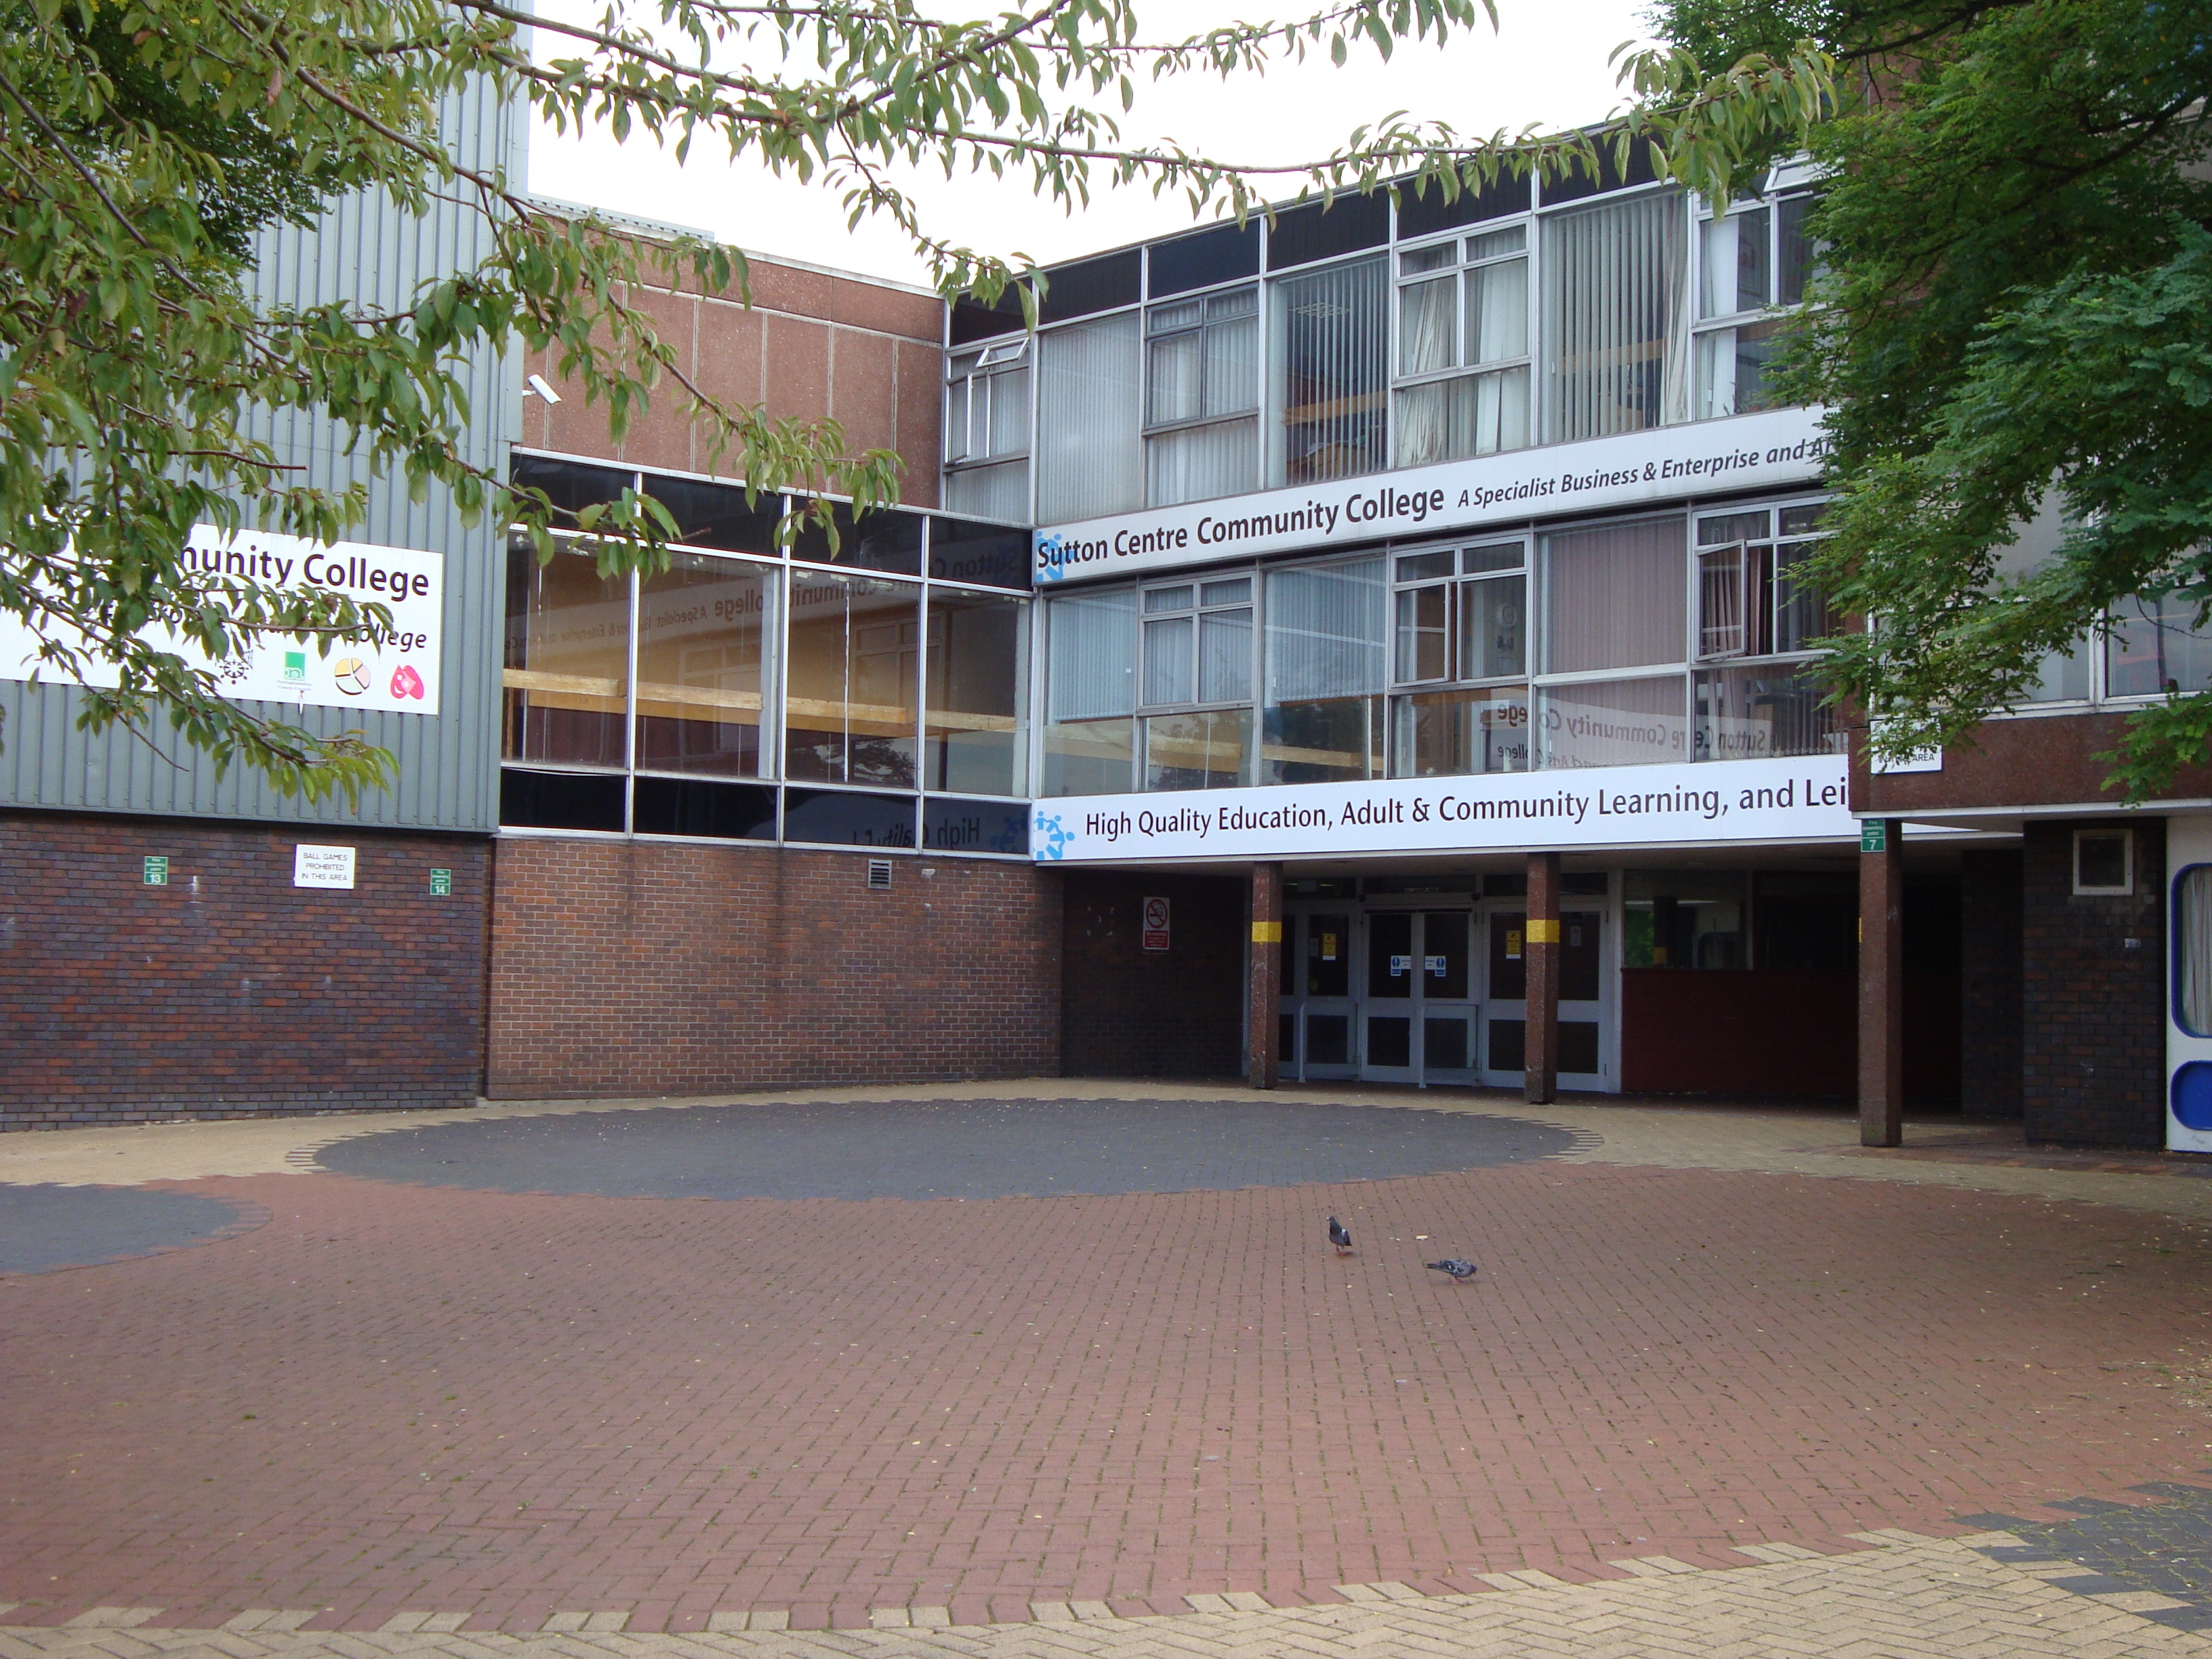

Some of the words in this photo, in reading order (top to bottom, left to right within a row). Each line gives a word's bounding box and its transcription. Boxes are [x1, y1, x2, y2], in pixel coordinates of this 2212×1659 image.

[1457, 489, 1469, 508] A
[1473, 477, 1556, 510] Specialist
[1561, 469, 1639, 493] Business
[1642, 462, 1657, 481] &
[1661, 448, 1760, 478] Enterprise
[1766, 438, 1806, 464] and
[1038, 539, 1108, 568] Sutton
[1115, 527, 1187, 556] Centre
[1197, 499, 1340, 545] Community
[1346, 487, 1445, 523] College
[304, 554, 429, 602] College
[1086, 811, 1131, 842] High
[1139, 807, 1212, 838] Quality
[1218, 803, 1333, 832] Education,
[1340, 798, 1404, 825] Adult
[1412, 798, 1430, 821] &
[1439, 790, 1589, 825] Community
[1599, 785, 1728, 819] Learning,
[1739, 779, 1793, 809] and
[1806, 777, 1846, 806] Lei
[1869, 840, 1877, 850] 7
[149, 874, 161, 883] 13
[306, 863, 344, 871] PROHIBITED
[434, 885, 445, 894] 14
